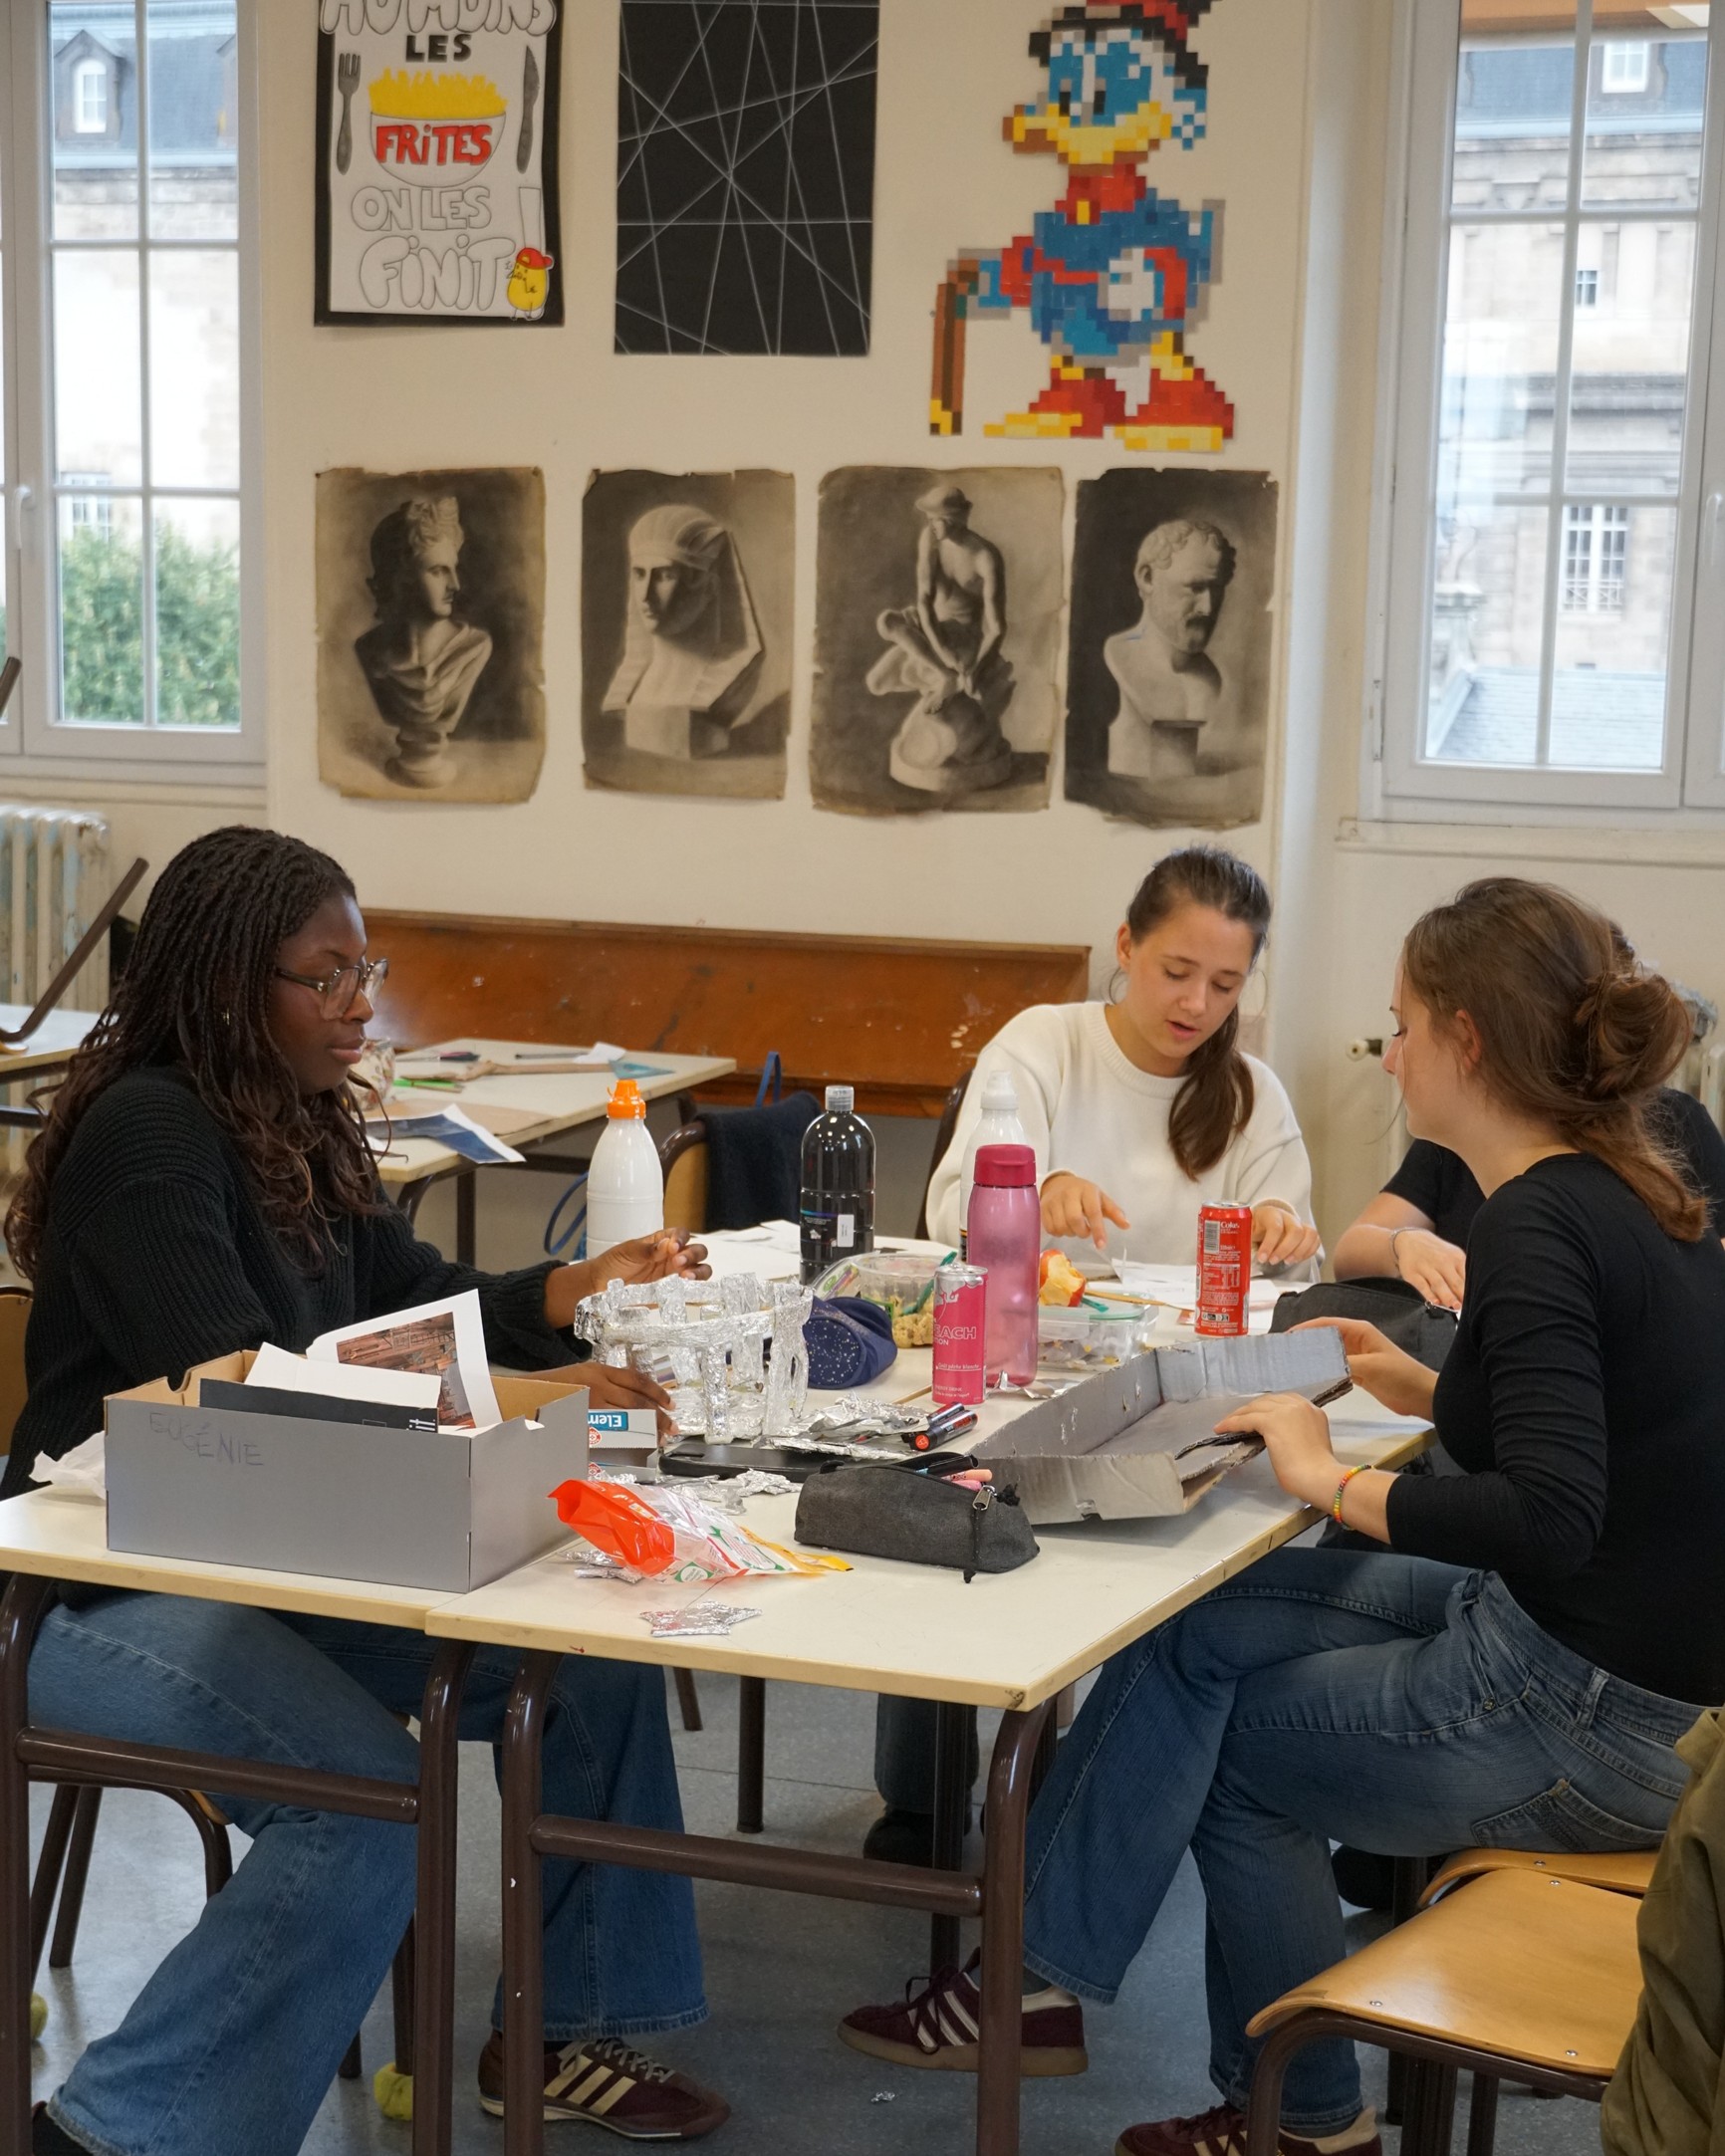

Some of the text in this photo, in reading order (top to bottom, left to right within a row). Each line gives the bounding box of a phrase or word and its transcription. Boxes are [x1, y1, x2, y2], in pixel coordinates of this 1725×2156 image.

[405, 34, 472, 63] LES
[351, 185, 492, 232] ON LES
